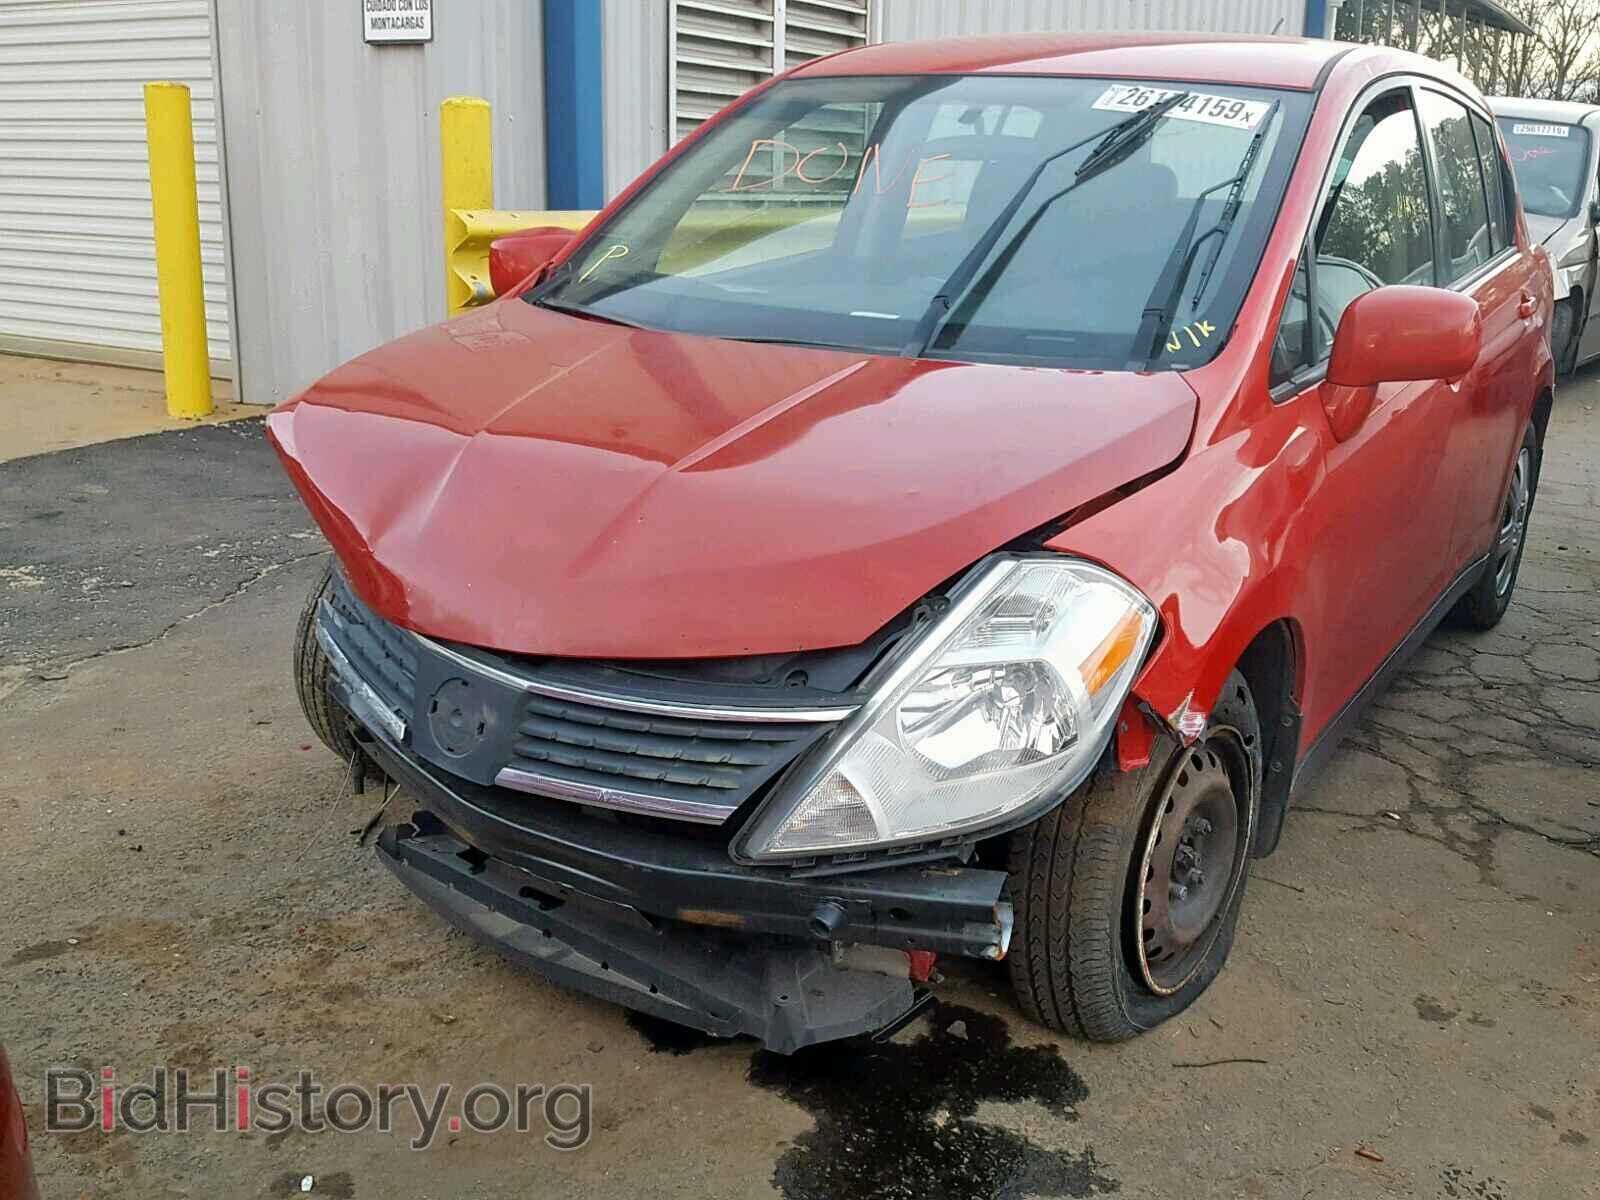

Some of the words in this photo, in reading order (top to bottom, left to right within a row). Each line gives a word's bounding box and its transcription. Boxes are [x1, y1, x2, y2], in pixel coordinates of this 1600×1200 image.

[366, 0, 396, 11] CUIDADO
[399, 0, 413, 11] CON
[415, 0, 428, 11] LOS
[370, 16, 424, 29] MONTACARGAS
[720, 139, 951, 208] DONE
[577, 244, 630, 284] P
